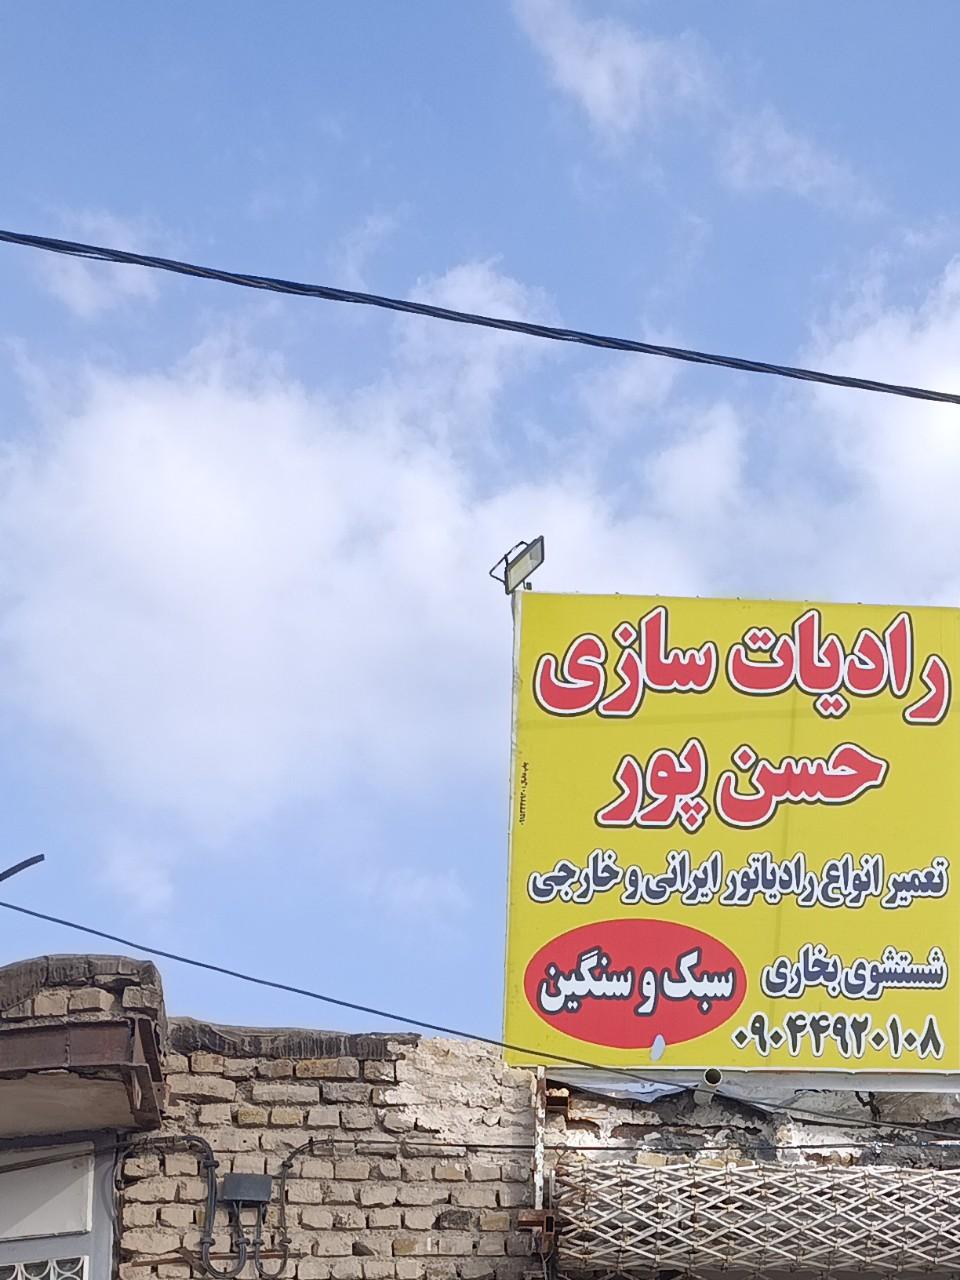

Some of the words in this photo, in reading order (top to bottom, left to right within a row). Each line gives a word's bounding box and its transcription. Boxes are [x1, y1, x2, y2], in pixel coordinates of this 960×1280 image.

[533, 606, 717, 716] سازی
[727, 610, 950, 724] رادیات
[595, 738, 709, 833] پور
[714, 742, 889, 829] حسن
[527, 848, 623, 905] خارجی
[624, 874, 643, 904] و
[641, 848, 722, 906] ایرانی
[722, 850, 820, 907] رادیاتور
[819, 850, 883, 908] انواع
[882, 856, 950, 908] تعمیر
[538, 946, 635, 1016] سنگین
[635, 966, 659, 1015] و
[659, 948, 737, 1016] سبک
[760, 942, 842, 999] بخاری
[841, 945, 949, 999] شستشوی
[730, 1011, 945, 1060] ۰۹۰۴۴۹۲۰۱۰۸
